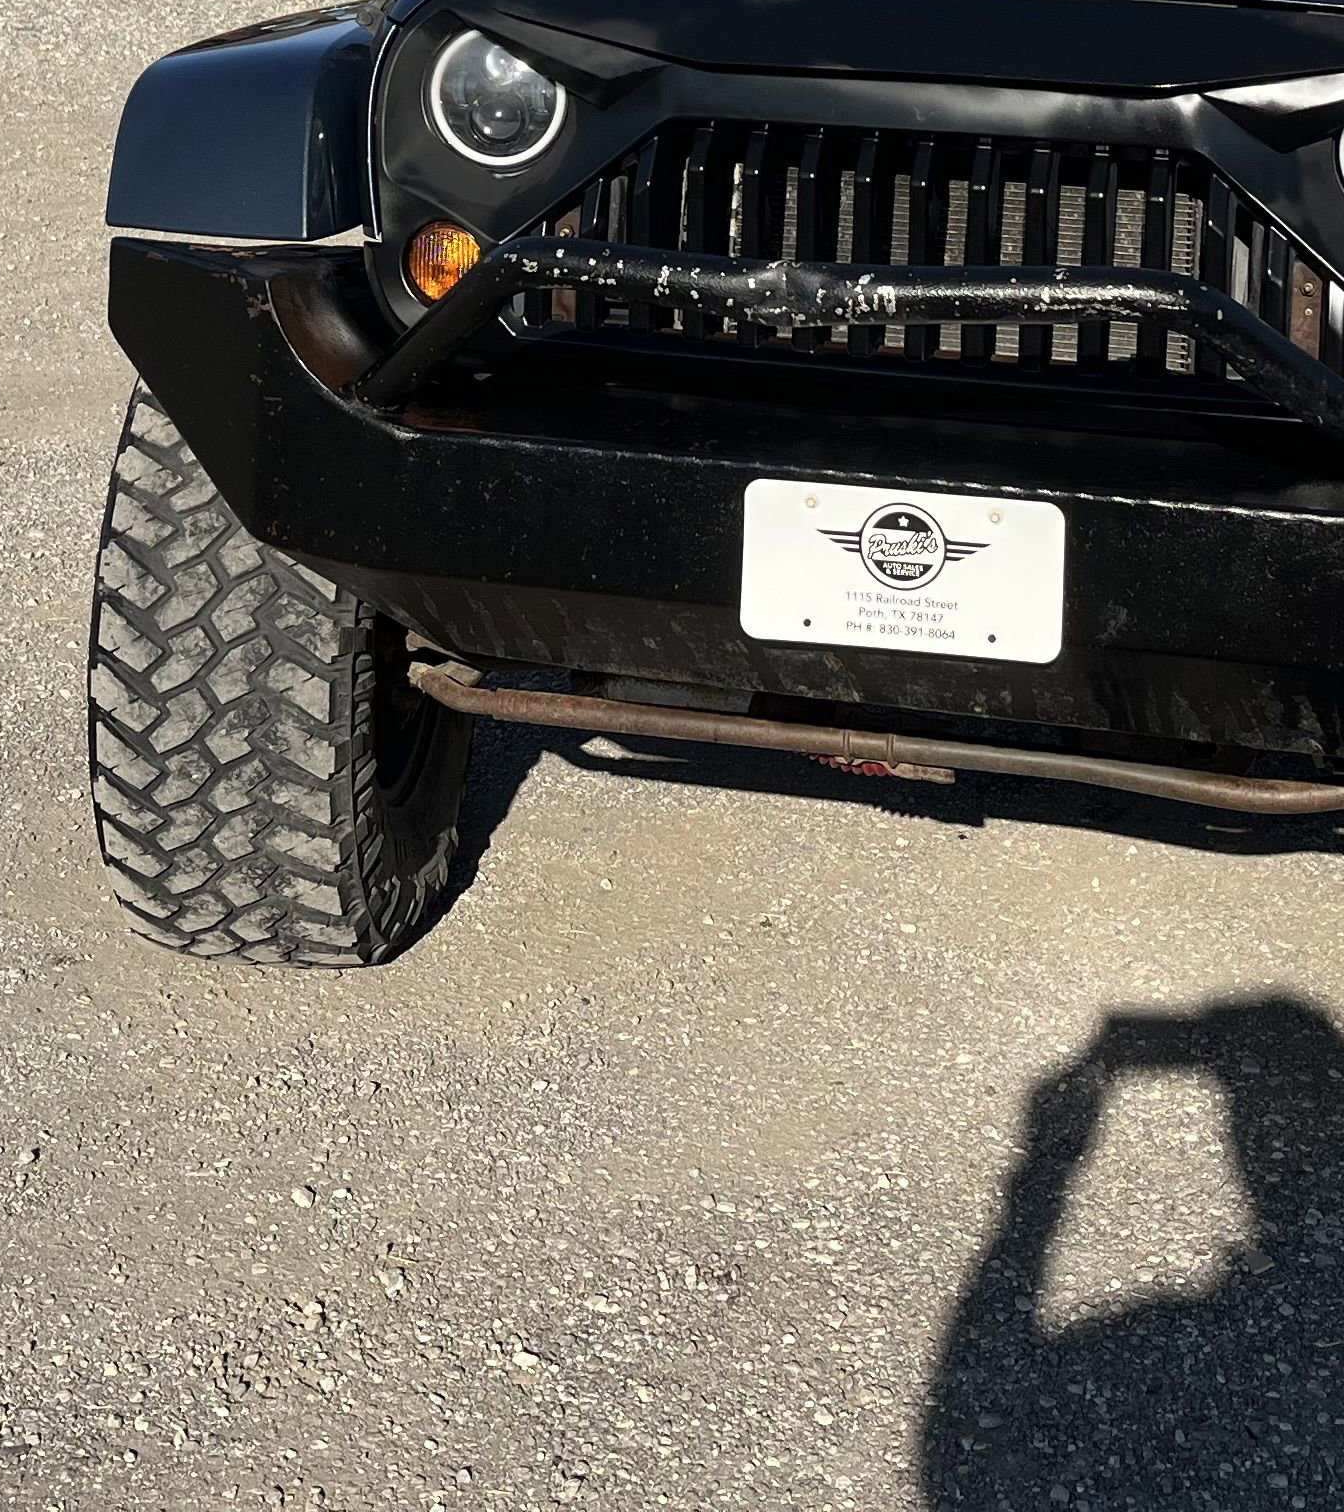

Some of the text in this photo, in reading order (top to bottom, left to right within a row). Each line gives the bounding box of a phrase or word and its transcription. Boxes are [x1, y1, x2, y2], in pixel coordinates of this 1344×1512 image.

[867, 531, 938, 559] Pruski's
[882, 562, 902, 570] AUTO
[846, 591, 958, 611] 1115 Railroad Street
[892, 609, 906, 621] TX
[910, 611, 943, 624] 78147
[846, 620, 862, 632] PH
[879, 623, 955, 640] 830-391-8064
